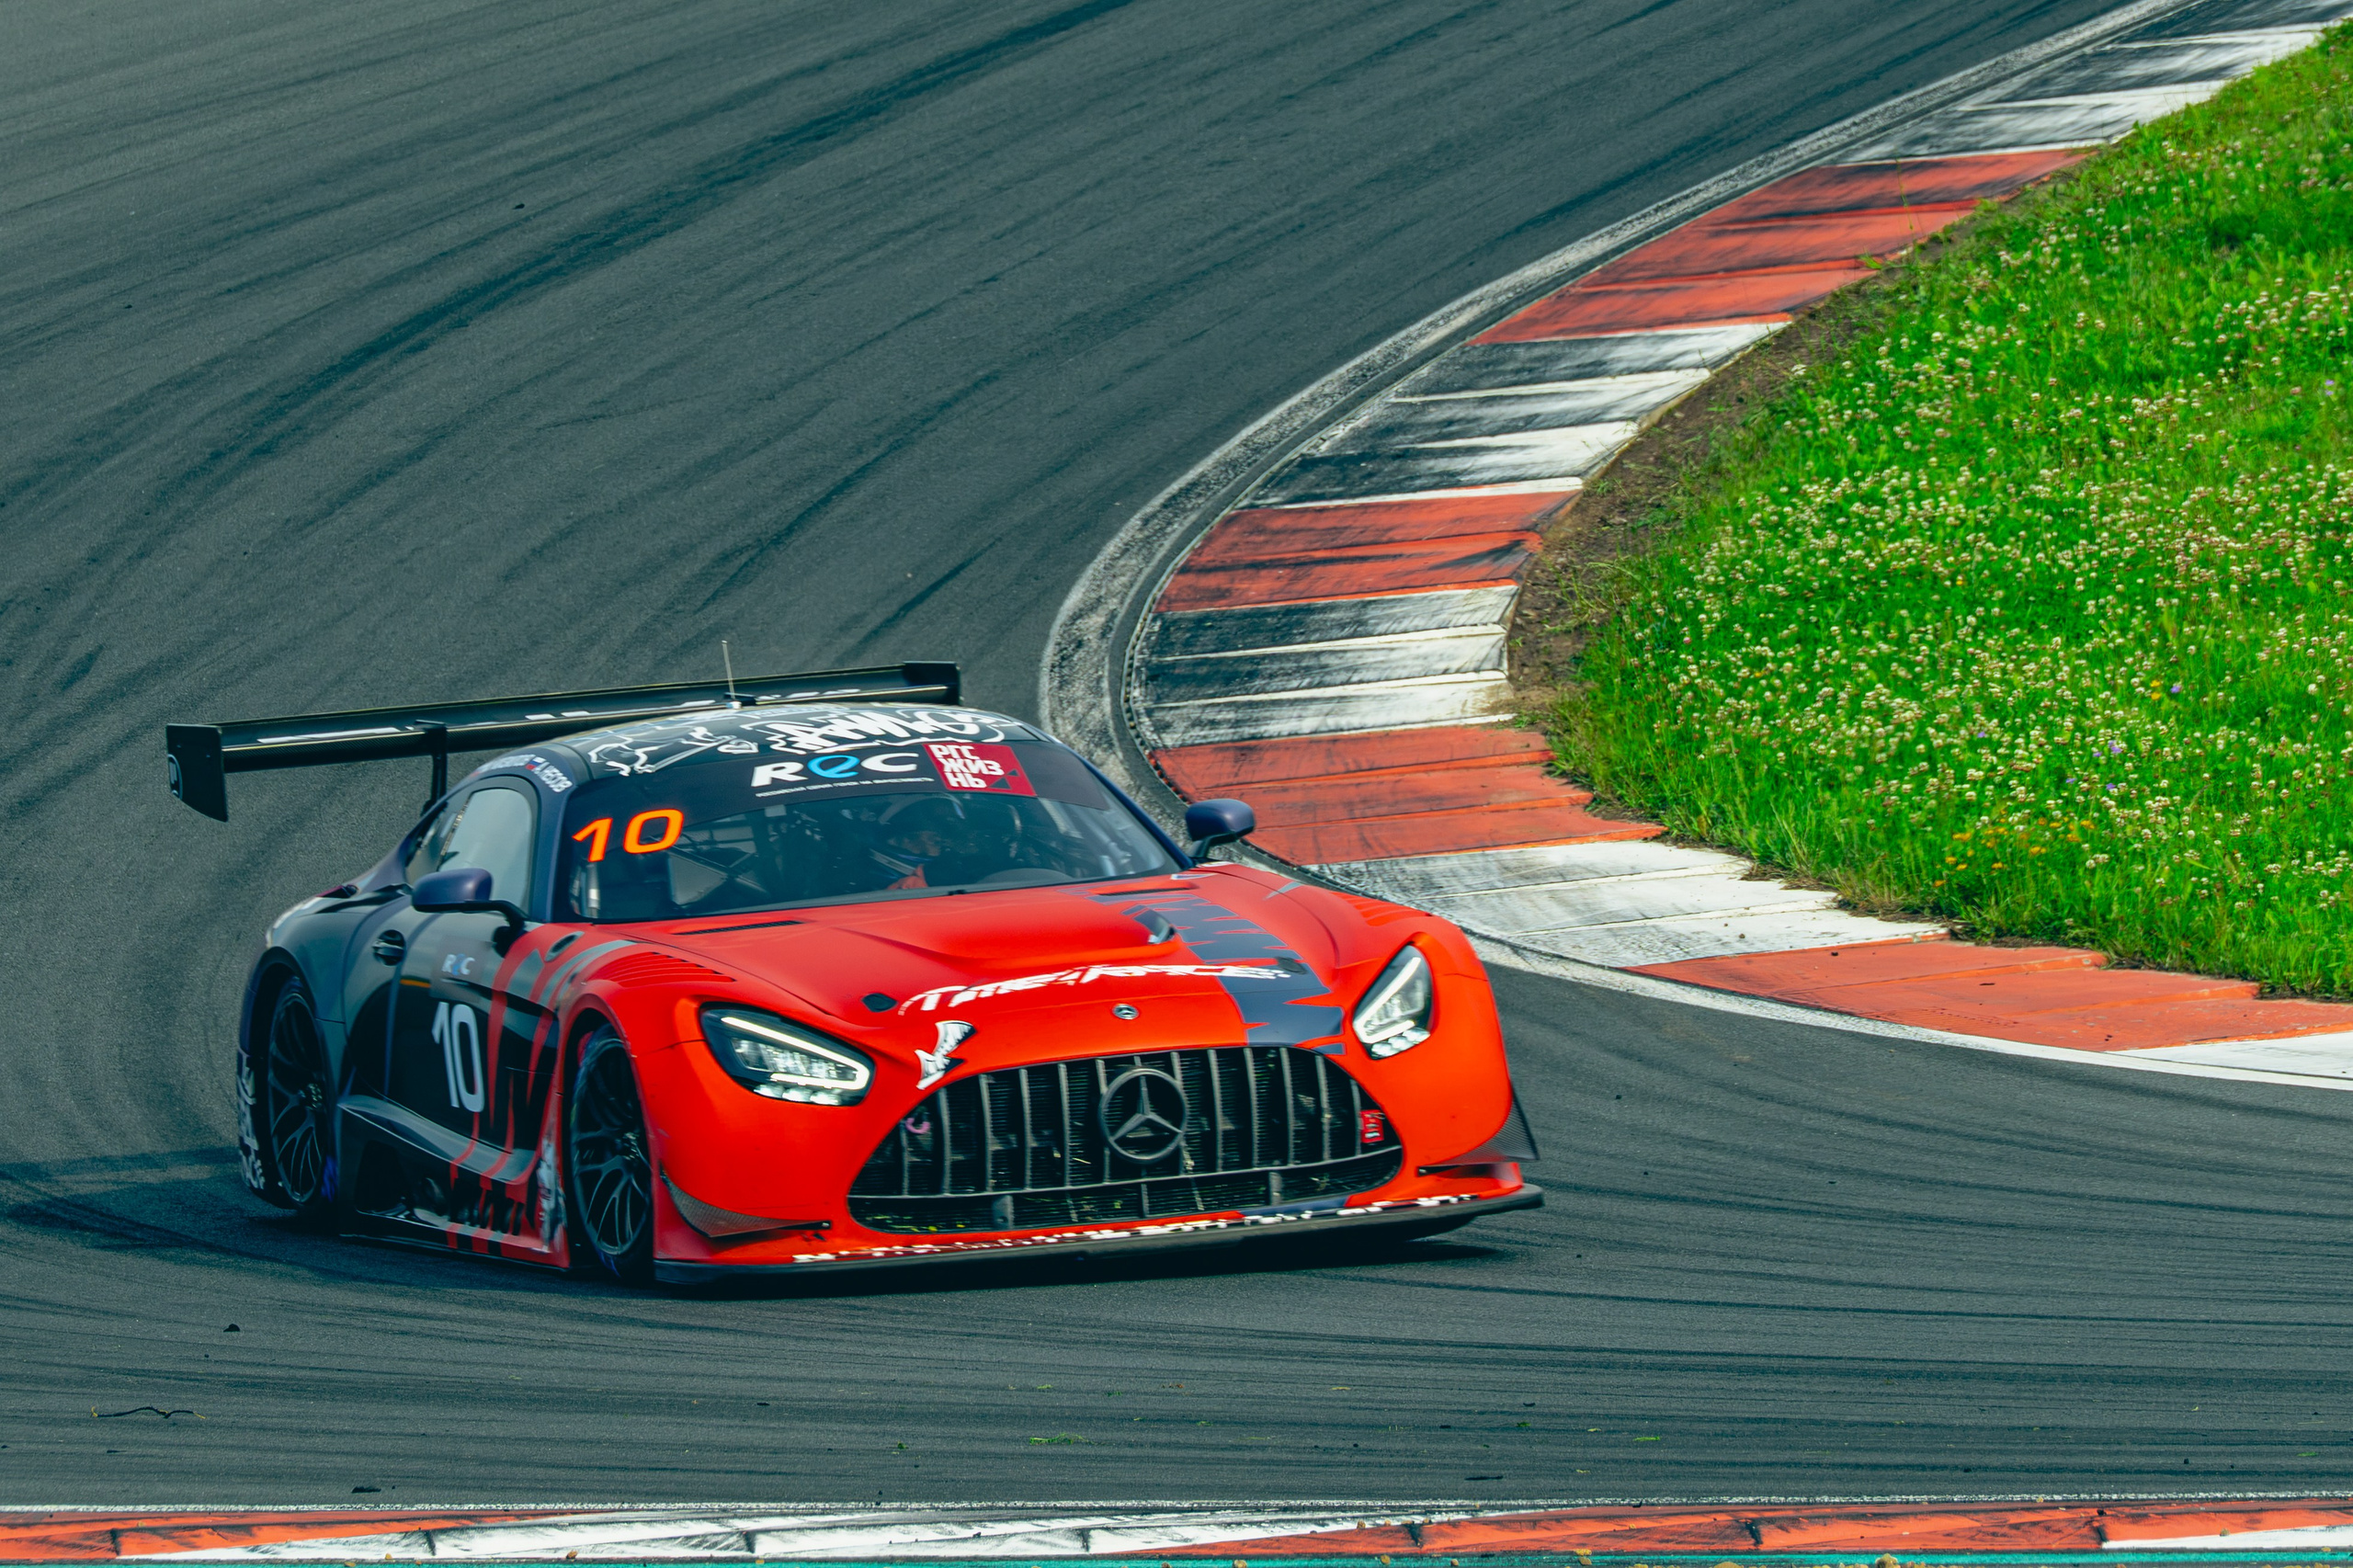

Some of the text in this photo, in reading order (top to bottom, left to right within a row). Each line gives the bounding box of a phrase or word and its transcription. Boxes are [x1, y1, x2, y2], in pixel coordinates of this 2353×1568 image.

[928, 744, 981, 760] РГС
[938, 758, 1006, 776] ЖИЗ
[944, 772, 987, 788] НЬ
[572, 809, 684, 862] 10
[431, 1001, 485, 1112] 10
